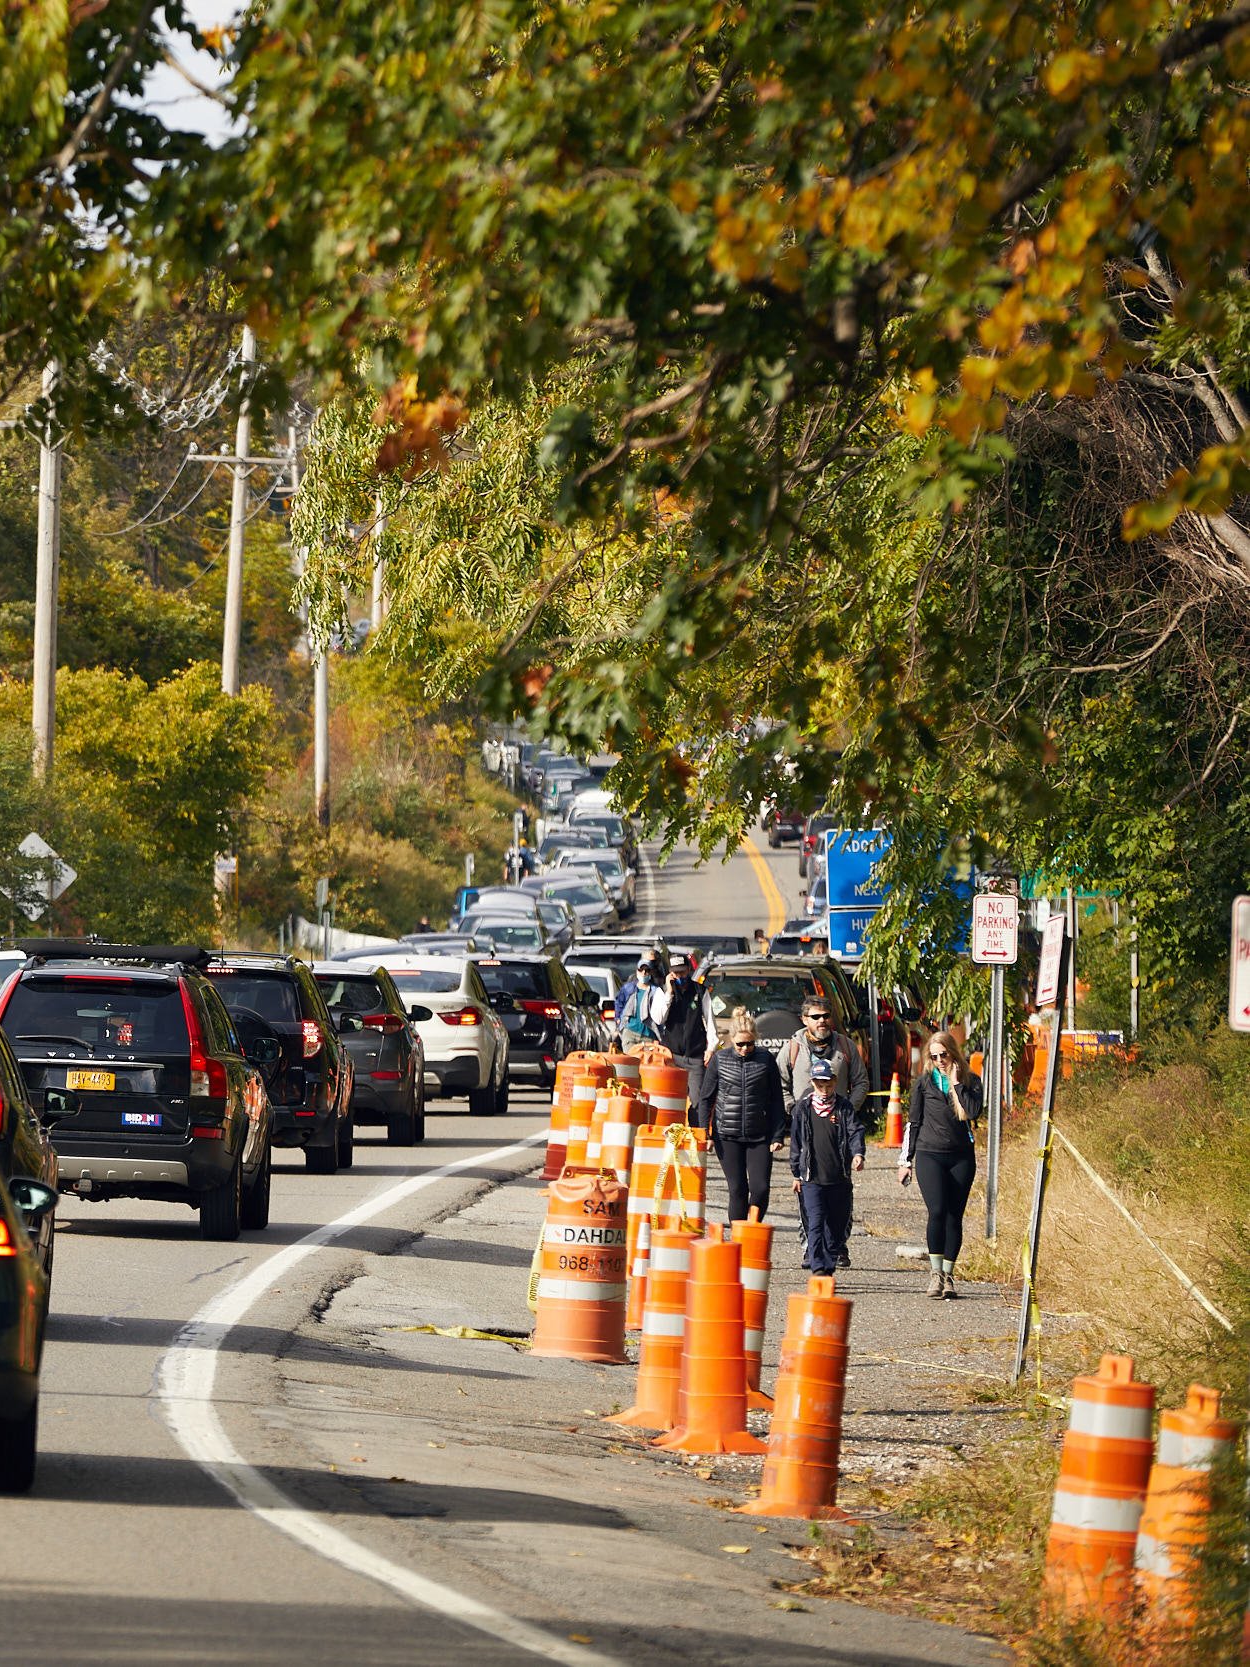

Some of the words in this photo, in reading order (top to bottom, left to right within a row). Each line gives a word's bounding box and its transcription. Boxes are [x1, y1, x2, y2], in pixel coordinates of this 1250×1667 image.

[988, 902, 1004, 915] NO
[977, 916, 1014, 930] PARKING
[987, 930, 1003, 939] ANY
[986, 940, 1004, 949] TIME
[47, 1051, 135, 1061] VOLVO
[125, 1113, 155, 1122] BIDEN
